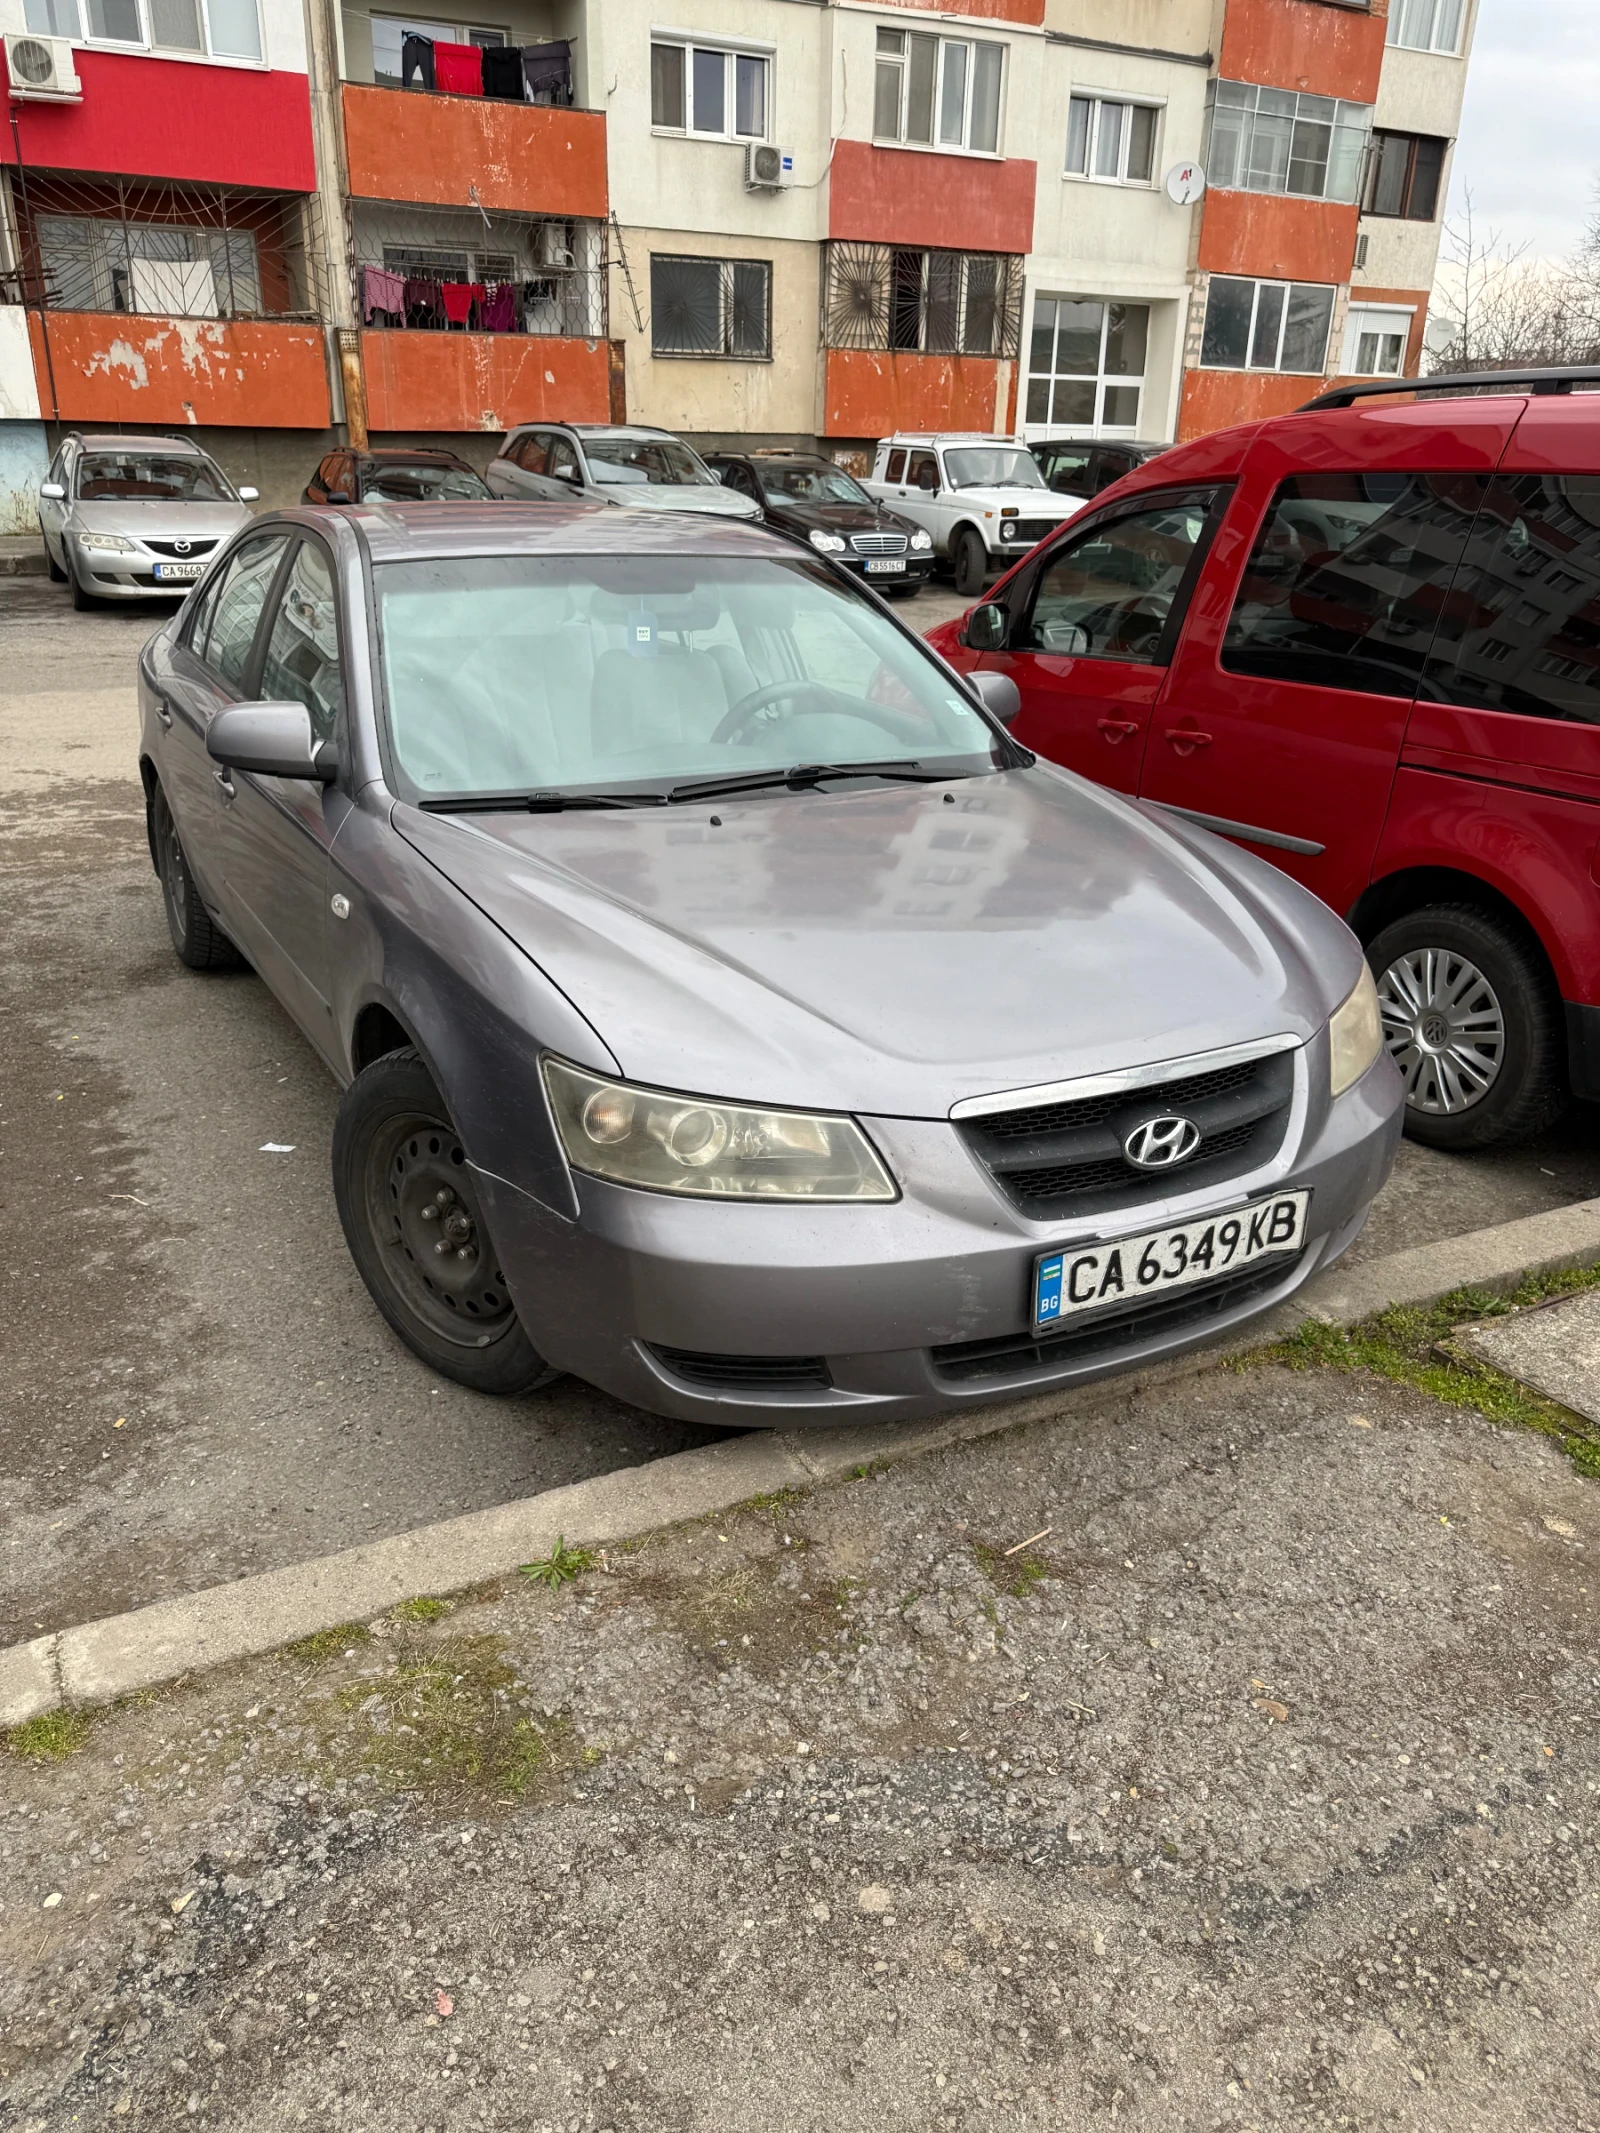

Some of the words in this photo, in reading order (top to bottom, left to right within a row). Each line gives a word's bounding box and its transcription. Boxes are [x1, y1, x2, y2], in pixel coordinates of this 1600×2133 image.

[162, 566, 176, 577] CA
[177, 566, 202, 576] 9668
[1068, 1249, 1124, 1304] CA
[1137, 1219, 1241, 1285] 6349
[1246, 1200, 1297, 1256] KB
[1040, 1295, 1058, 1313] BG
